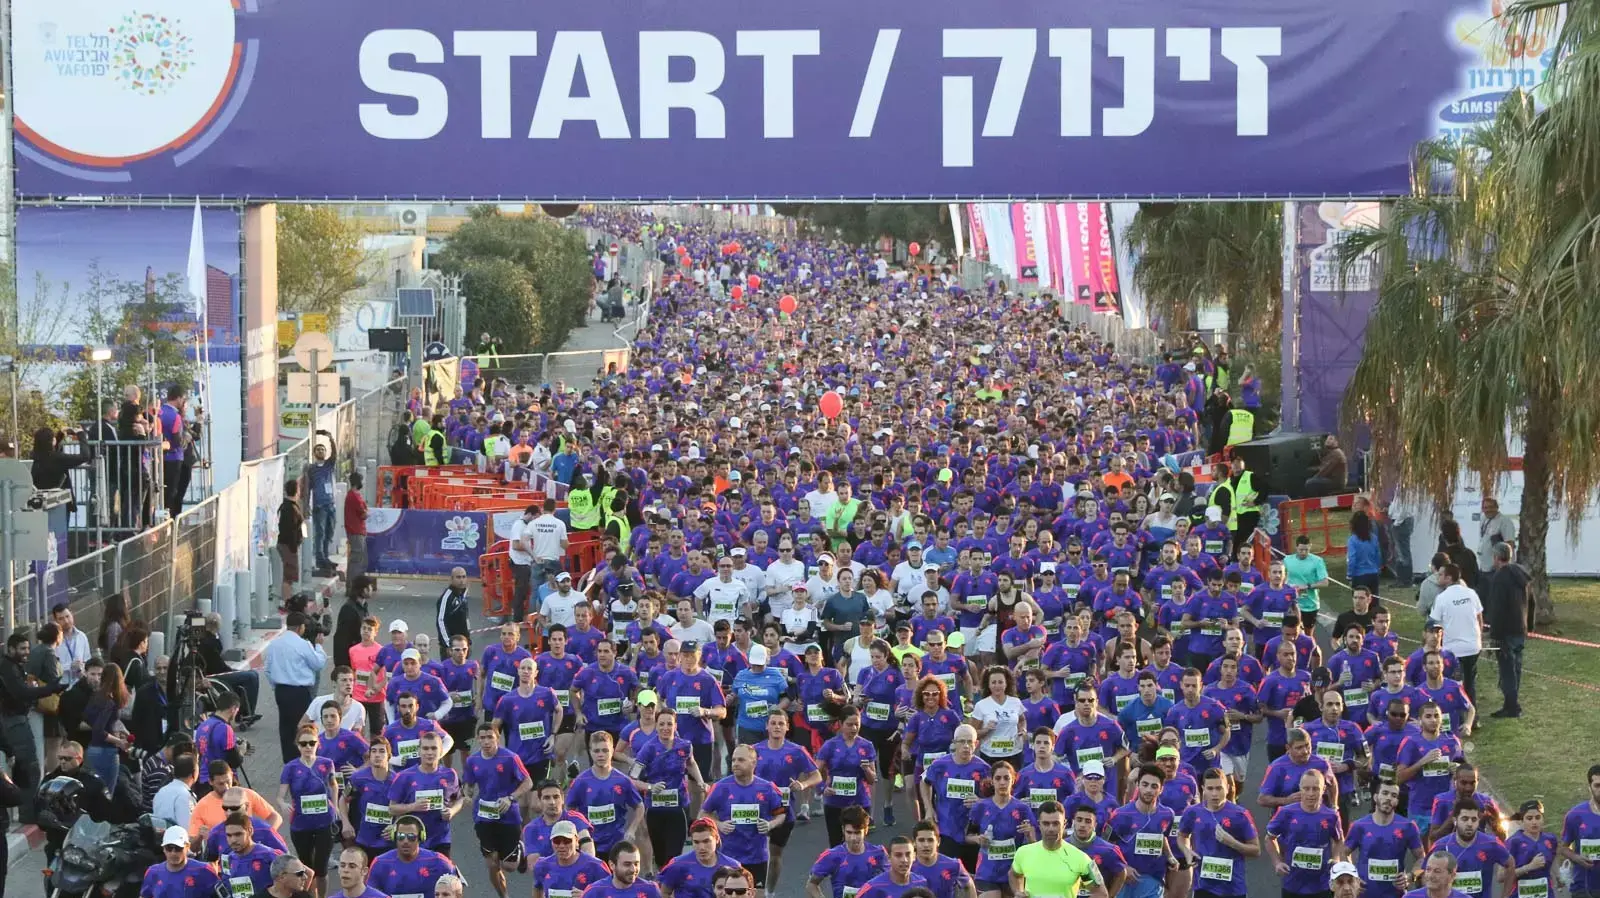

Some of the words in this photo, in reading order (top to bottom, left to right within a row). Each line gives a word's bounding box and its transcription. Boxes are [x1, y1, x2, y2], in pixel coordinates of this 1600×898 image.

[67, 36, 89, 48] TEL
[90, 33, 110, 48] תל
[44, 51, 75, 62] AVIV
[75, 49, 110, 62] אביב
[56, 63, 91, 76] YAFO
[91, 63, 110, 76] יפו
[1469, 69, 1535, 89] מרתון
[359, 30, 819, 139] START
[850, 29, 901, 138] /
[942, 27, 1282, 167] זינוק
[1451, 101, 1501, 115] SAMS
